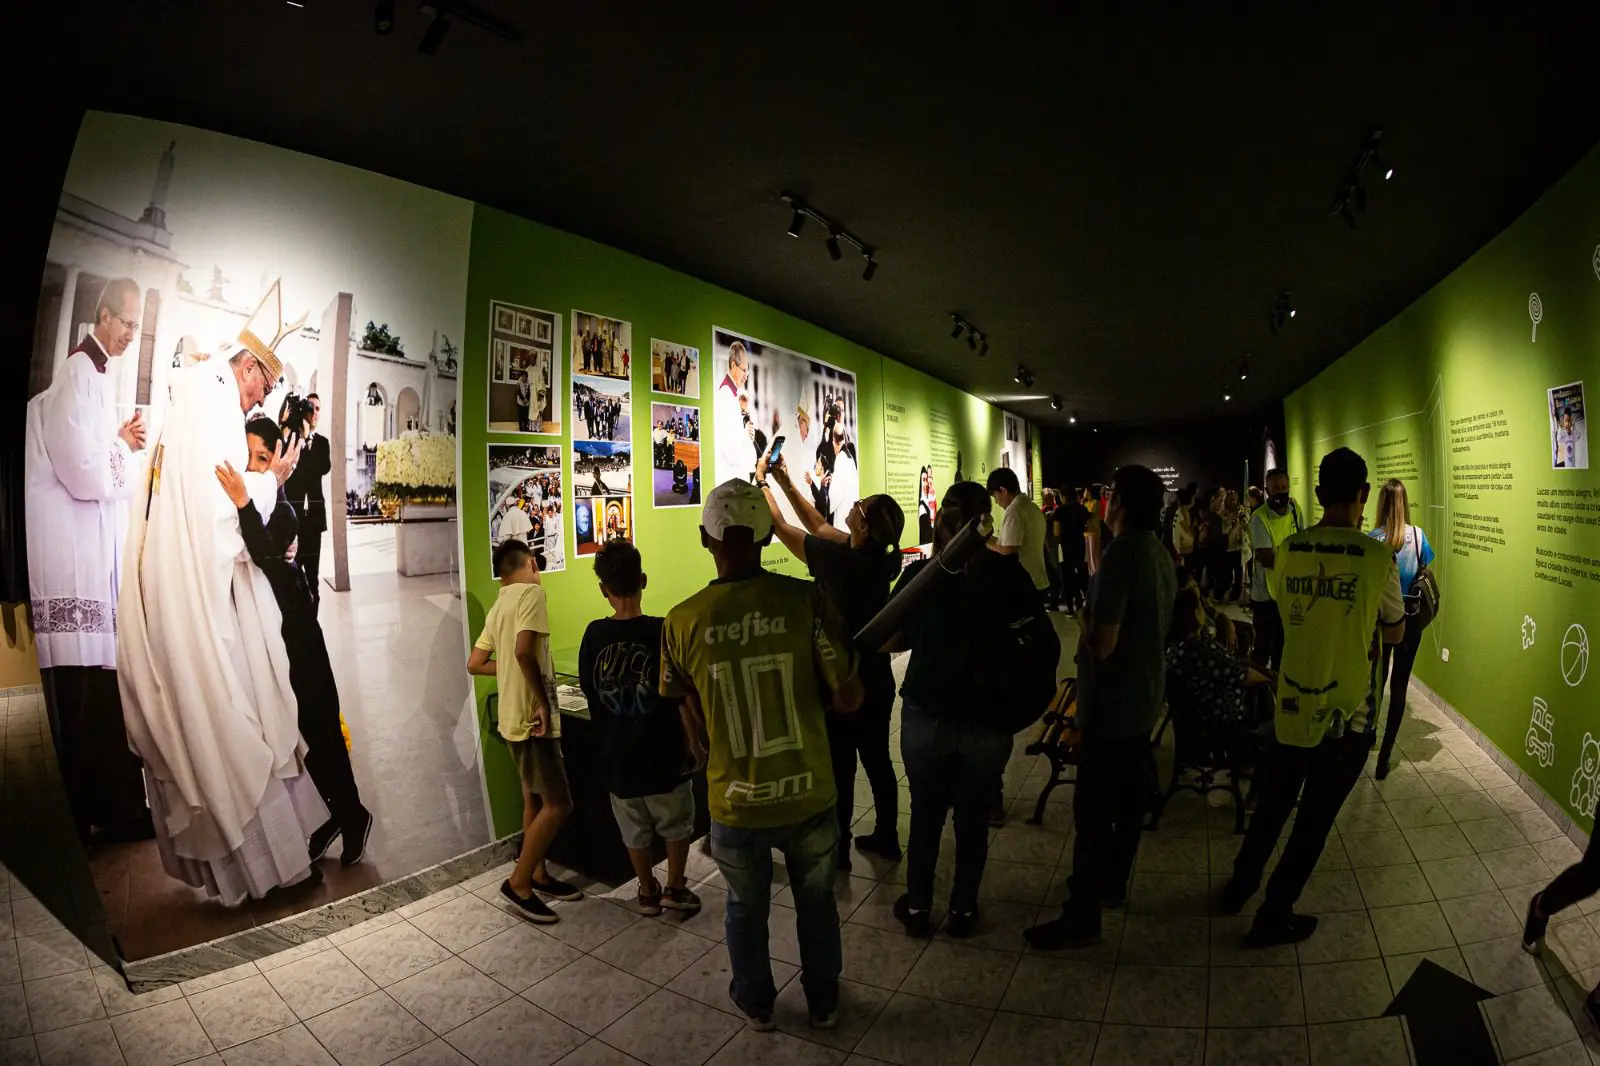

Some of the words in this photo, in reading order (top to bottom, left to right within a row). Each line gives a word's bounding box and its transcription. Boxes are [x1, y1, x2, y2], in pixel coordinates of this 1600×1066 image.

[1536, 488, 1550, 496] Lucas
[1536, 500, 1548, 508] muito
[1549, 500, 1560, 508] ativo
[1560, 502, 1574, 510] como
[1556, 514, 1562, 522] no
[1562, 515, 1574, 524] auge
[1536, 524, 1546, 532] anos
[1563, 565, 1569, 573] do
[1286, 576, 1313, 596] ROTA
[704, 611, 787, 645] crefisa
[707, 652, 804, 759] 10
